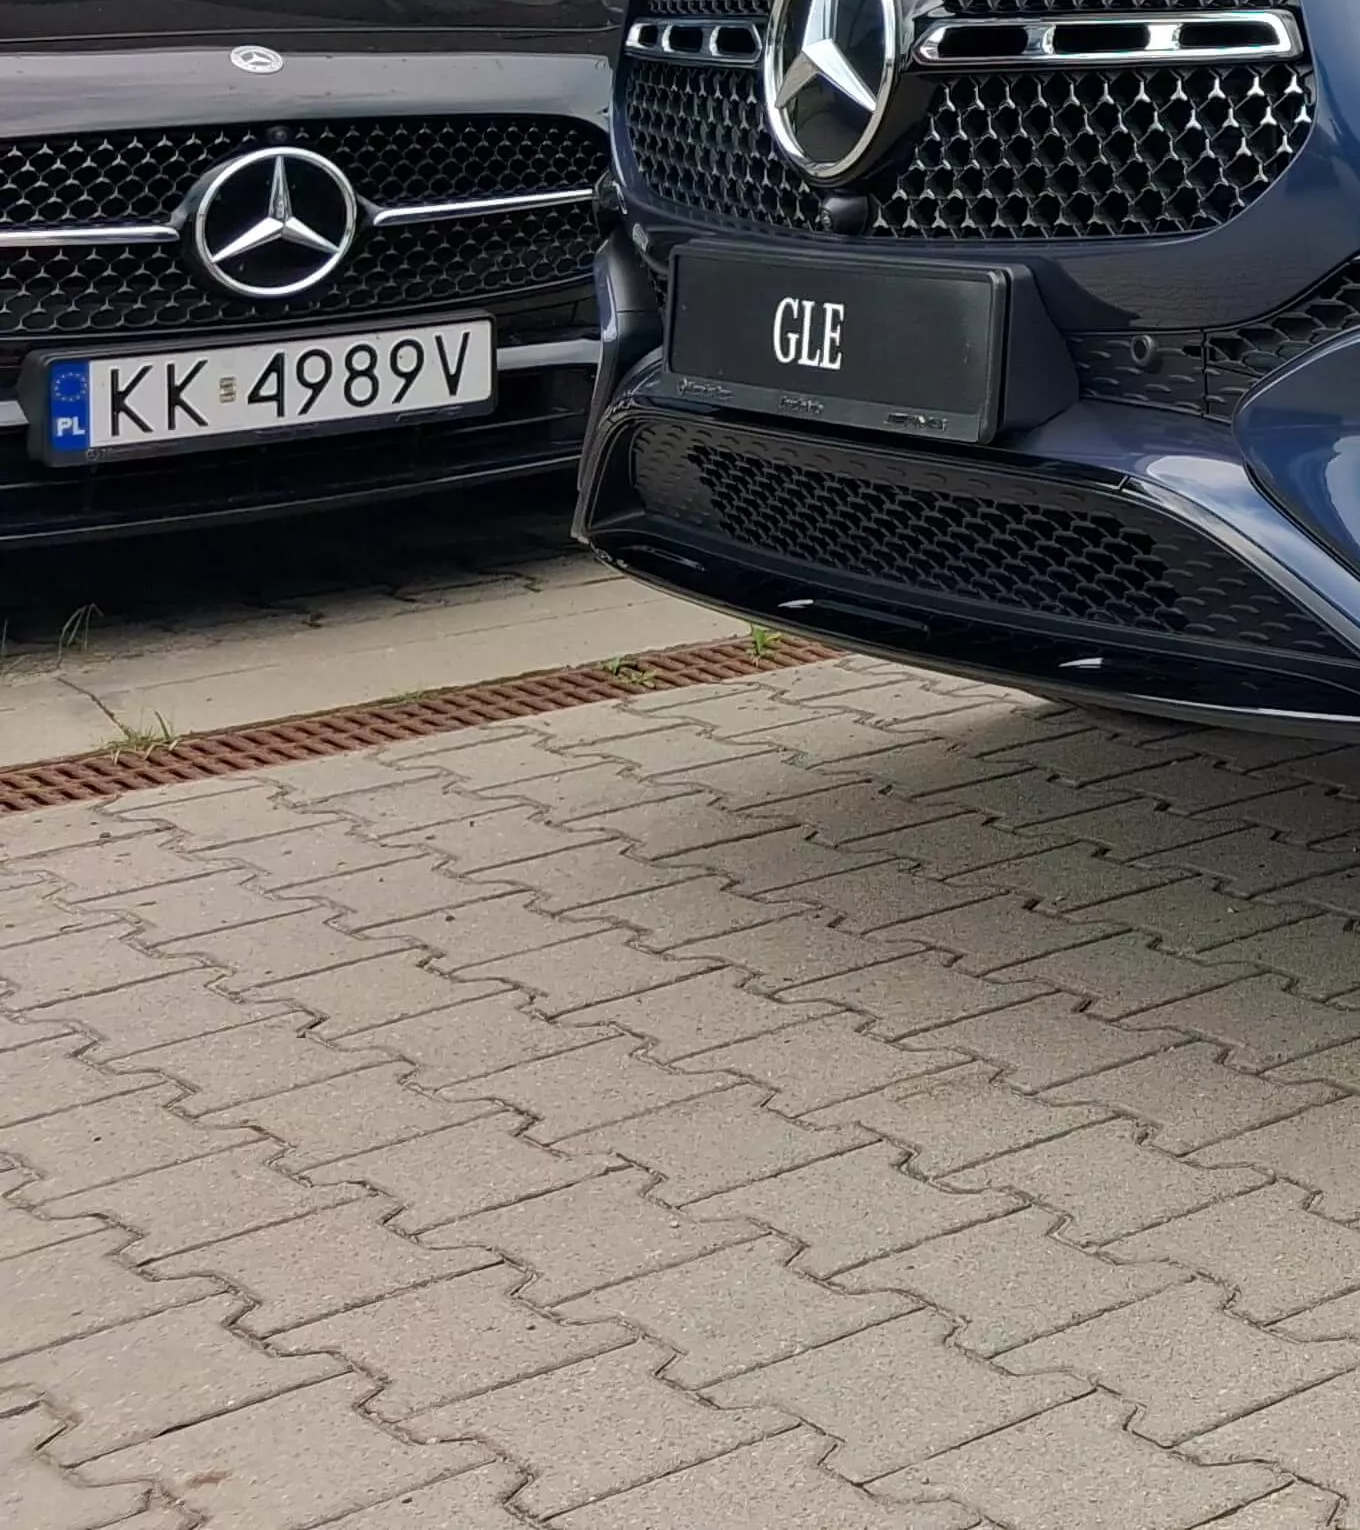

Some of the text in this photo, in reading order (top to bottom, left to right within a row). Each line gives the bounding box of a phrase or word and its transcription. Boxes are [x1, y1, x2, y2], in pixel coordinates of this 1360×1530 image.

[773, 296, 845, 370] GLE
[110, 332, 471, 437] KK 4989V
[56, 416, 86, 437] PL
